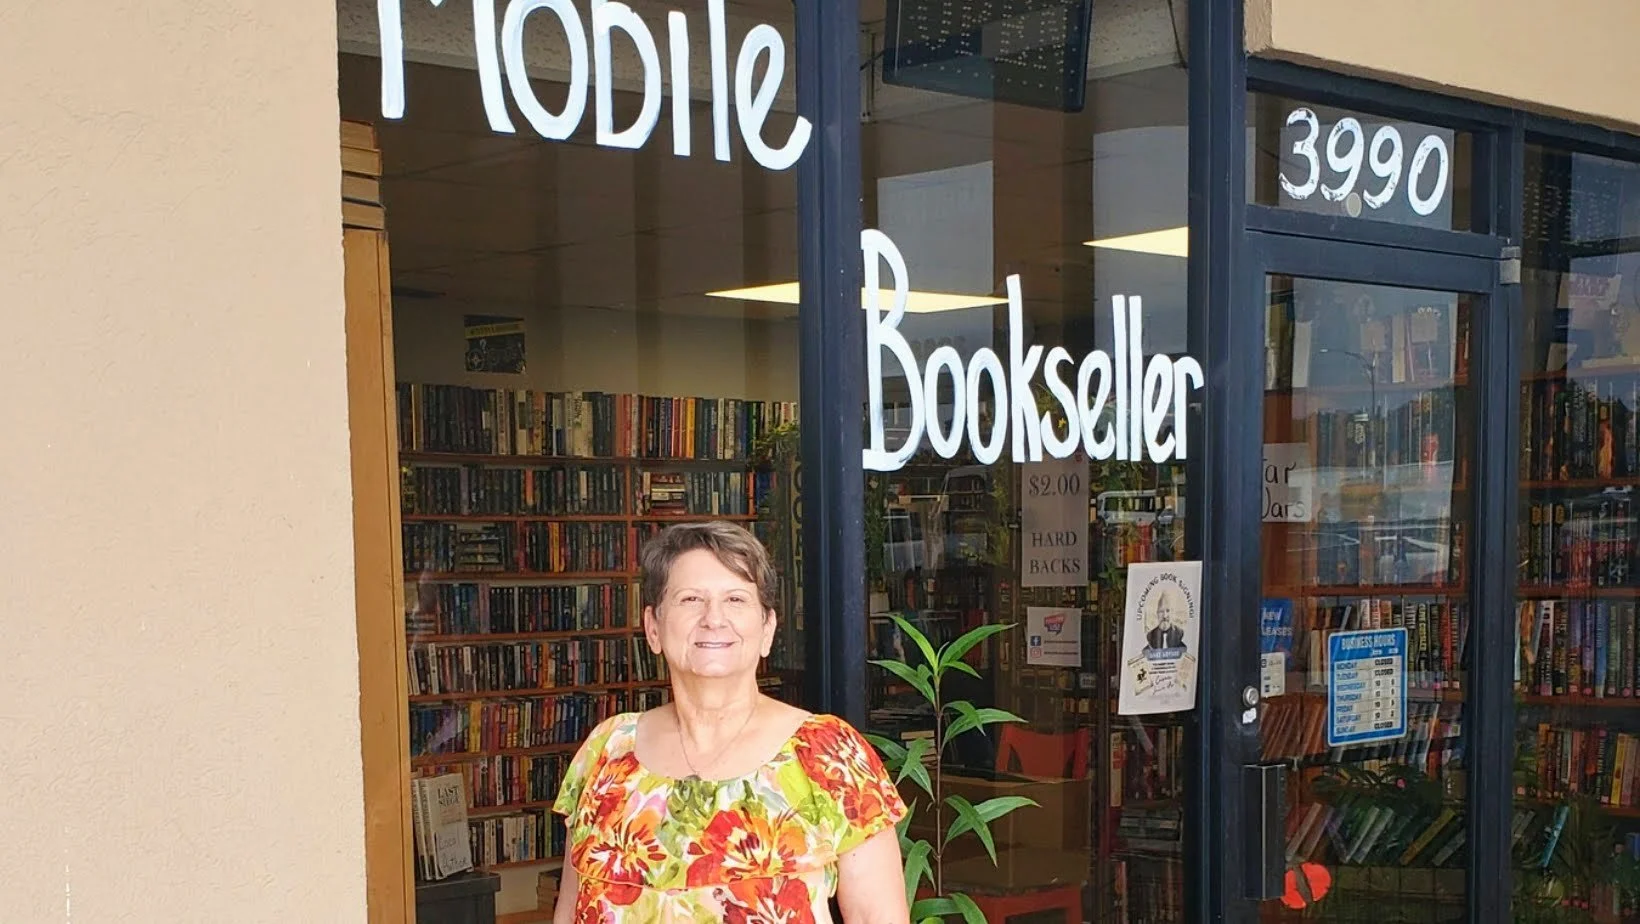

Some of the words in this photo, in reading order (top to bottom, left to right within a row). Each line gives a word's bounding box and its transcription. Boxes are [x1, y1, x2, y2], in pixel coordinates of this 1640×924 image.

[1279, 107, 1449, 216] 3990
[860, 228, 1204, 472] Bookseller
[1262, 459, 1297, 484] ar
[1029, 473, 1080, 496] $2.00
[1032, 531, 1078, 547] HARD
[1029, 558, 1081, 575] BACKS
[1136, 577, 1159, 621] UPCOMING
[1160, 573, 1178, 583] BOOK
[1261, 626, 1292, 637] LEASES
[1341, 636, 1373, 651] BUSINESS
[1373, 633, 1396, 648] HOURS
[1336, 661, 1358, 671] MONDAY
[1374, 657, 1394, 666] CLOSED
[1374, 668, 1394, 677] CLOSED
[1374, 721, 1393, 730] CLOSED
